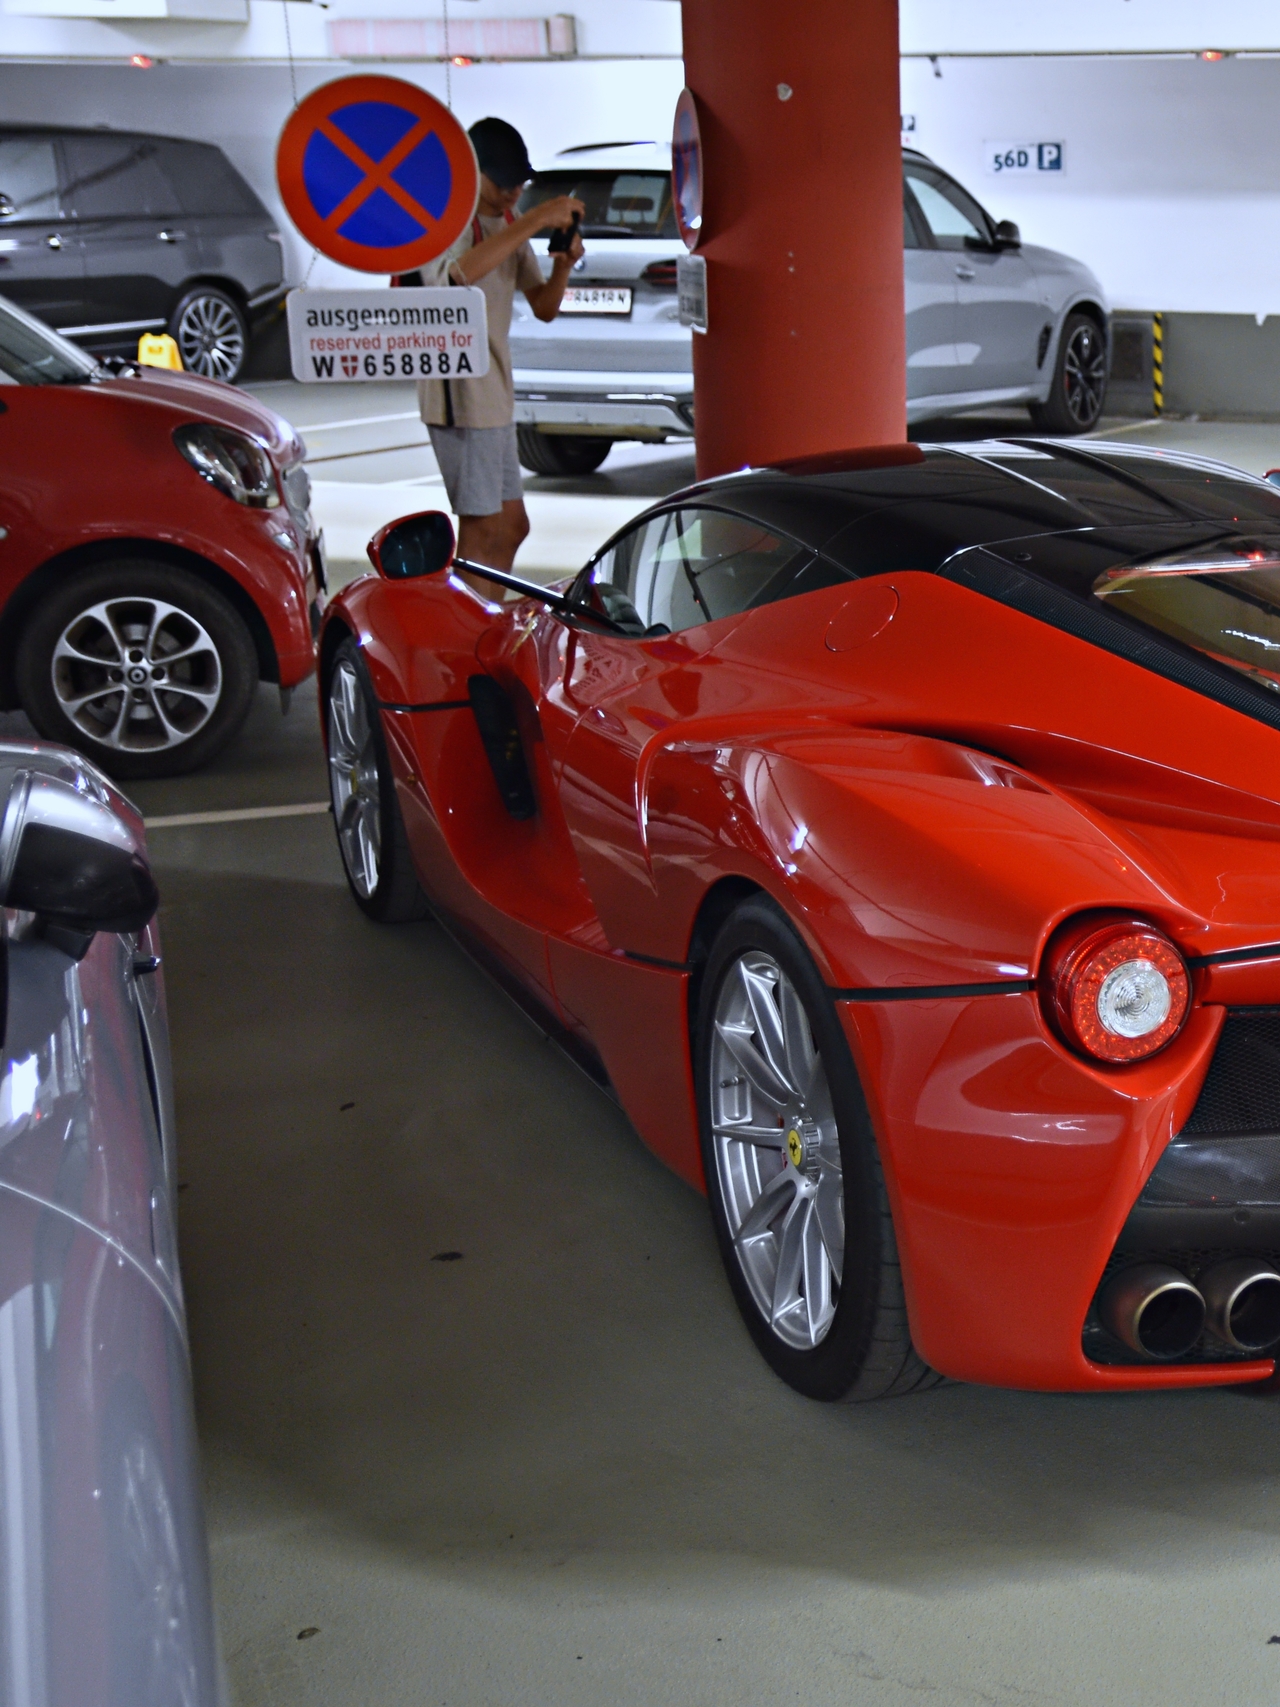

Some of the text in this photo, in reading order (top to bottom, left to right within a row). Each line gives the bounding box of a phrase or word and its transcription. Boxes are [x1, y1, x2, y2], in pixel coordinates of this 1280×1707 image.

[994, 144, 1059, 173] 56D P
[306, 306, 470, 331] ausgenommen
[310, 330, 473, 353] reserved parking for
[312, 355, 335, 378] W
